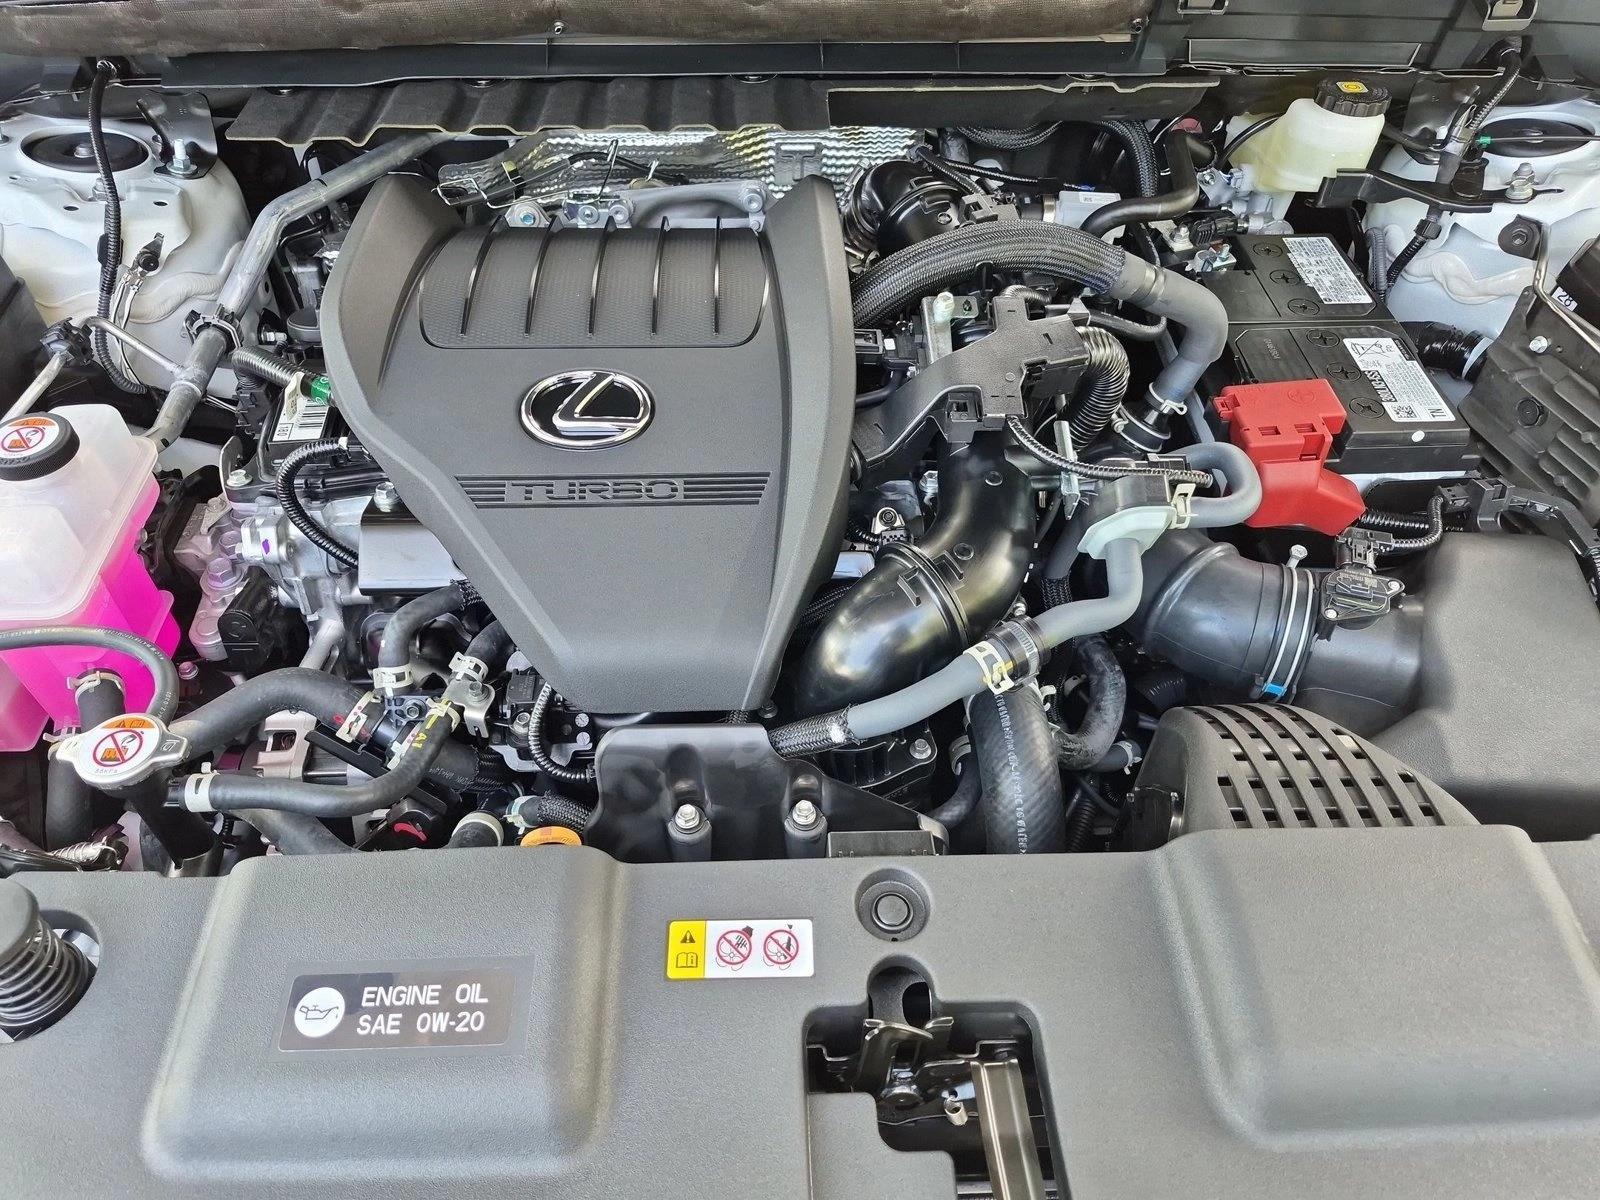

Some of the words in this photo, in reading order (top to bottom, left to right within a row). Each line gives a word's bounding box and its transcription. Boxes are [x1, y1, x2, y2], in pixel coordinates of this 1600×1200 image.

[509, 478, 680, 501] TURBO
[361, 984, 442, 1007] ENGINE
[455, 983, 489, 1004] OIL
[356, 1012, 401, 1035] SAE
[416, 1010, 485, 1034] 0W-20
